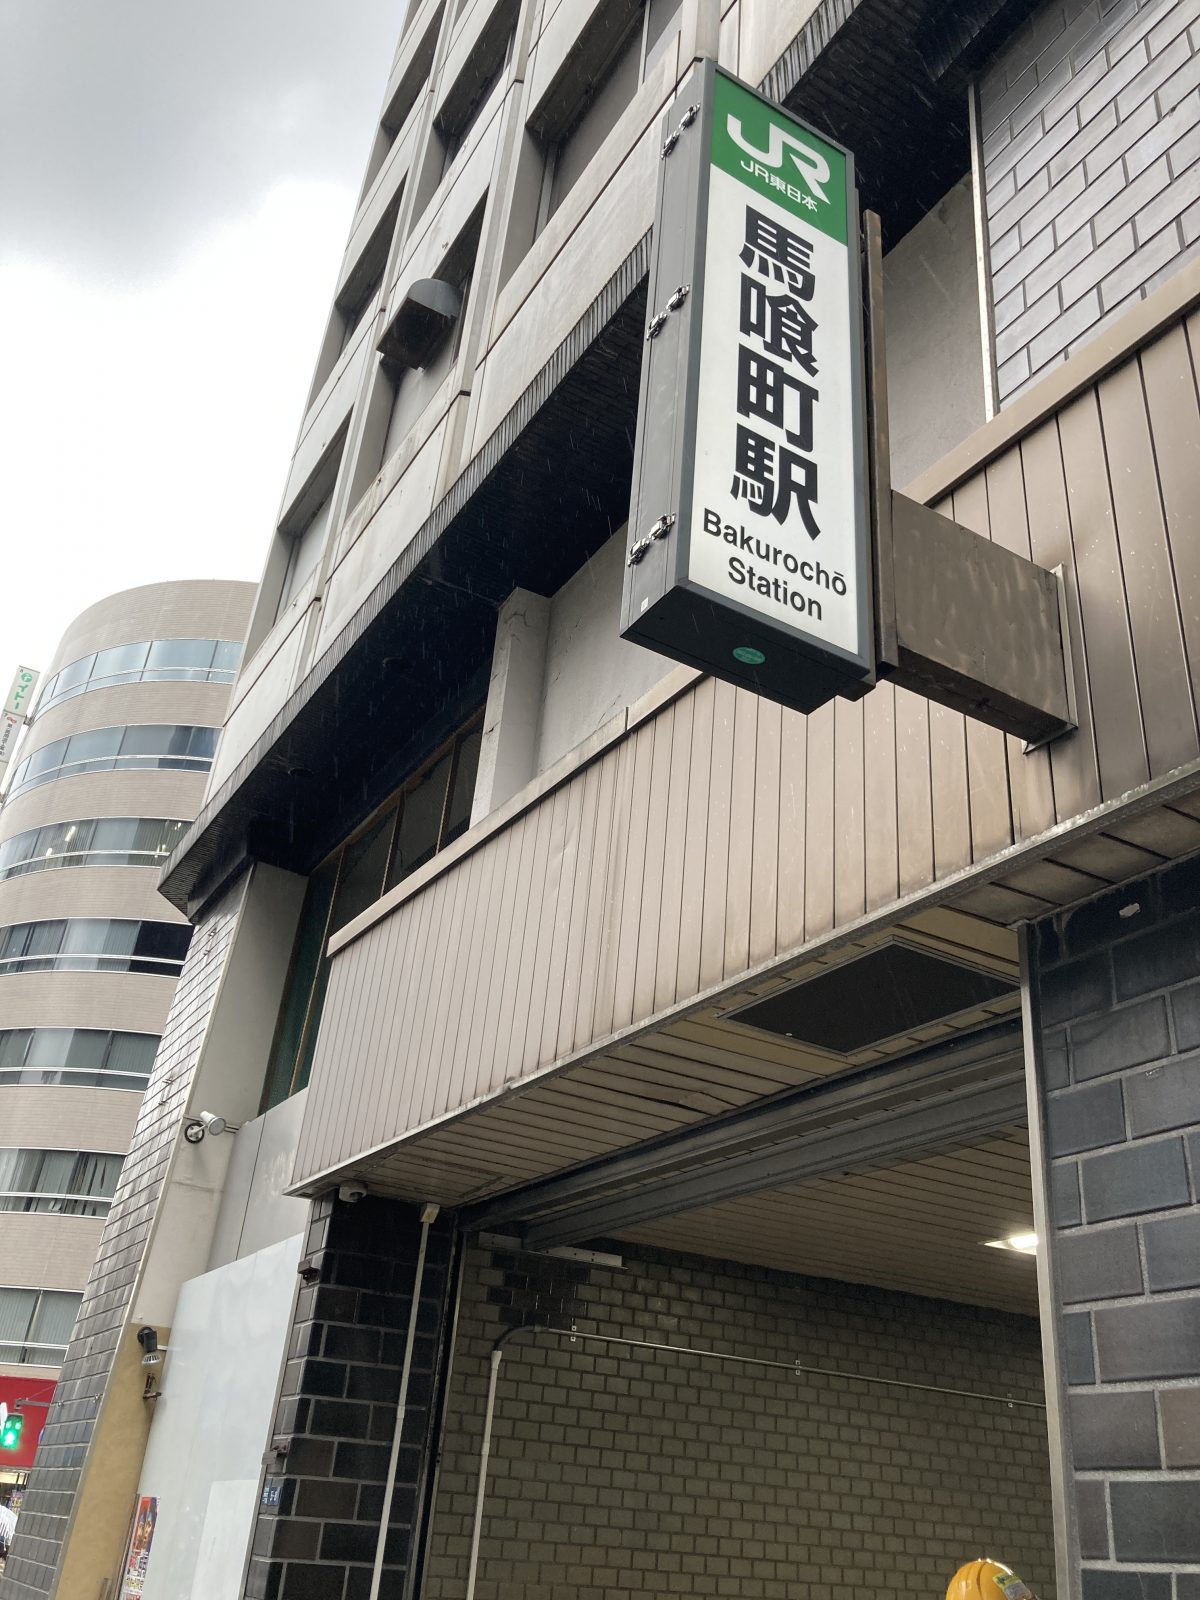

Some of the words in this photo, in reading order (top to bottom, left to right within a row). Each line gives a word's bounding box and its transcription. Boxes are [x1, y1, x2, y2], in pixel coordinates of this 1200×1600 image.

[727, 113, 831, 204] JR
[740, 159, 818, 213] JR東日本
[730, 204, 821, 541] 馬喰町駅
[703, 507, 847, 596] Bakurochō
[728, 556, 822, 621] Station
